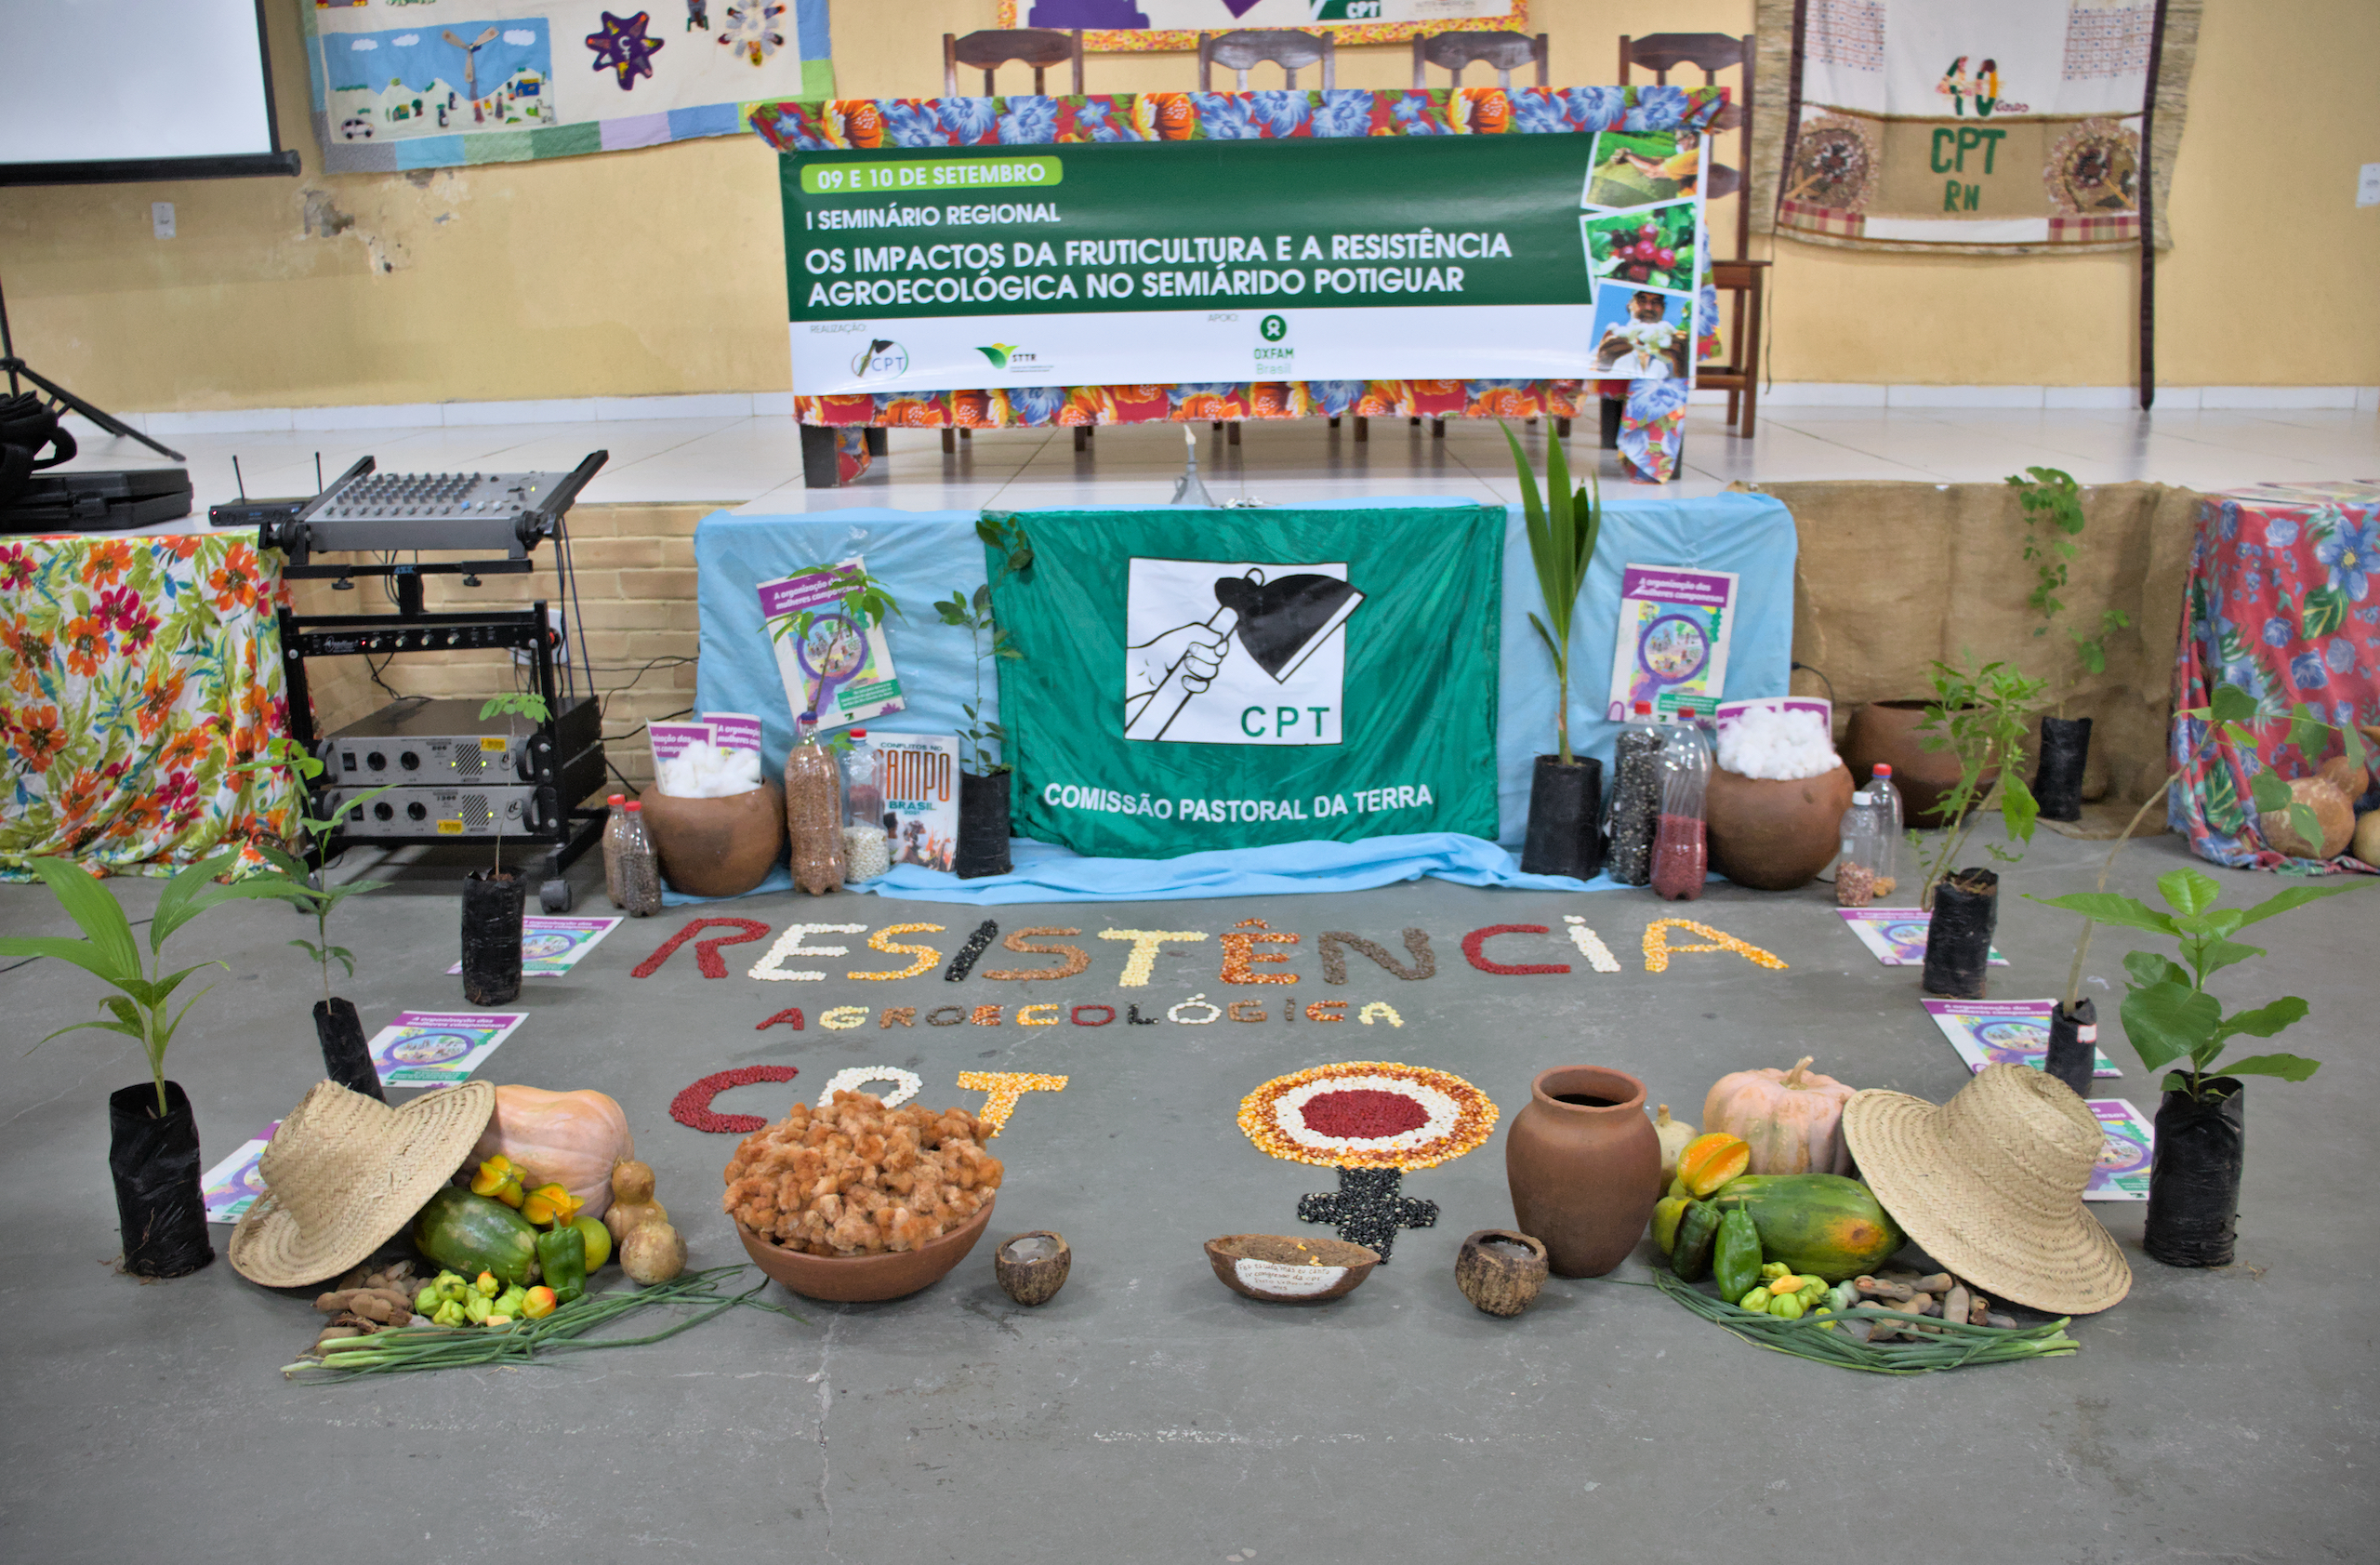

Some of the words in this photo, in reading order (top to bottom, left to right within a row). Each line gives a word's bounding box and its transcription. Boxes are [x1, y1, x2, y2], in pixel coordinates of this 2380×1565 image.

[1345, 1, 1380, 19] CPT
[1935, 56, 1998, 116] 40
[1930, 126, 2006, 174] CPT
[817, 170, 843, 190] 09
[850, 169, 861, 188] E
[869, 168, 893, 188] 10
[900, 167, 927, 186] DE
[932, 163, 1046, 186] SETEMBRO
[1944, 179, 1980, 212] RN
[806, 211, 813, 230] I
[818, 202, 941, 230] SEMINÁRIO
[946, 203, 1061, 226] REGIONAL
[805, 247, 846, 274] OS
[853, 243, 1005, 272] IMPACTOS
[1013, 241, 1057, 269] DA
[1065, 235, 1267, 267] FRUTICULTURA
[1276, 235, 1291, 260] E
[1300, 234, 1325, 260] A
[1331, 228, 1513, 259] RESISTÊNCIA
[807, 270, 1079, 308] AGROECOLÓGICA
[1087, 272, 1134, 299] NO
[1142, 262, 1305, 298] SEMIÁRIDO
[1315, 266, 1464, 296] POTIGUAR
[872, 356, 906, 372] CPT
[1012, 353, 1037, 362] STTR
[1253, 348, 1294, 360] OXFAM
[1256, 364, 1291, 374] Brasil
[1241, 706, 1329, 738] CPT
[880, 742, 927, 750] CONFLITOS
[889, 801, 937, 811] BRASIL
[1043, 782, 1172, 821] COMISSÃO
[1179, 798, 1307, 823] PASTORAL
[1314, 794, 1348, 818] DA
[1353, 784, 1433, 814] TERRA
[630, 915, 1790, 987] RESISTÊNCIA
[755, 992, 1405, 1030] AGROECOLÓGICA
